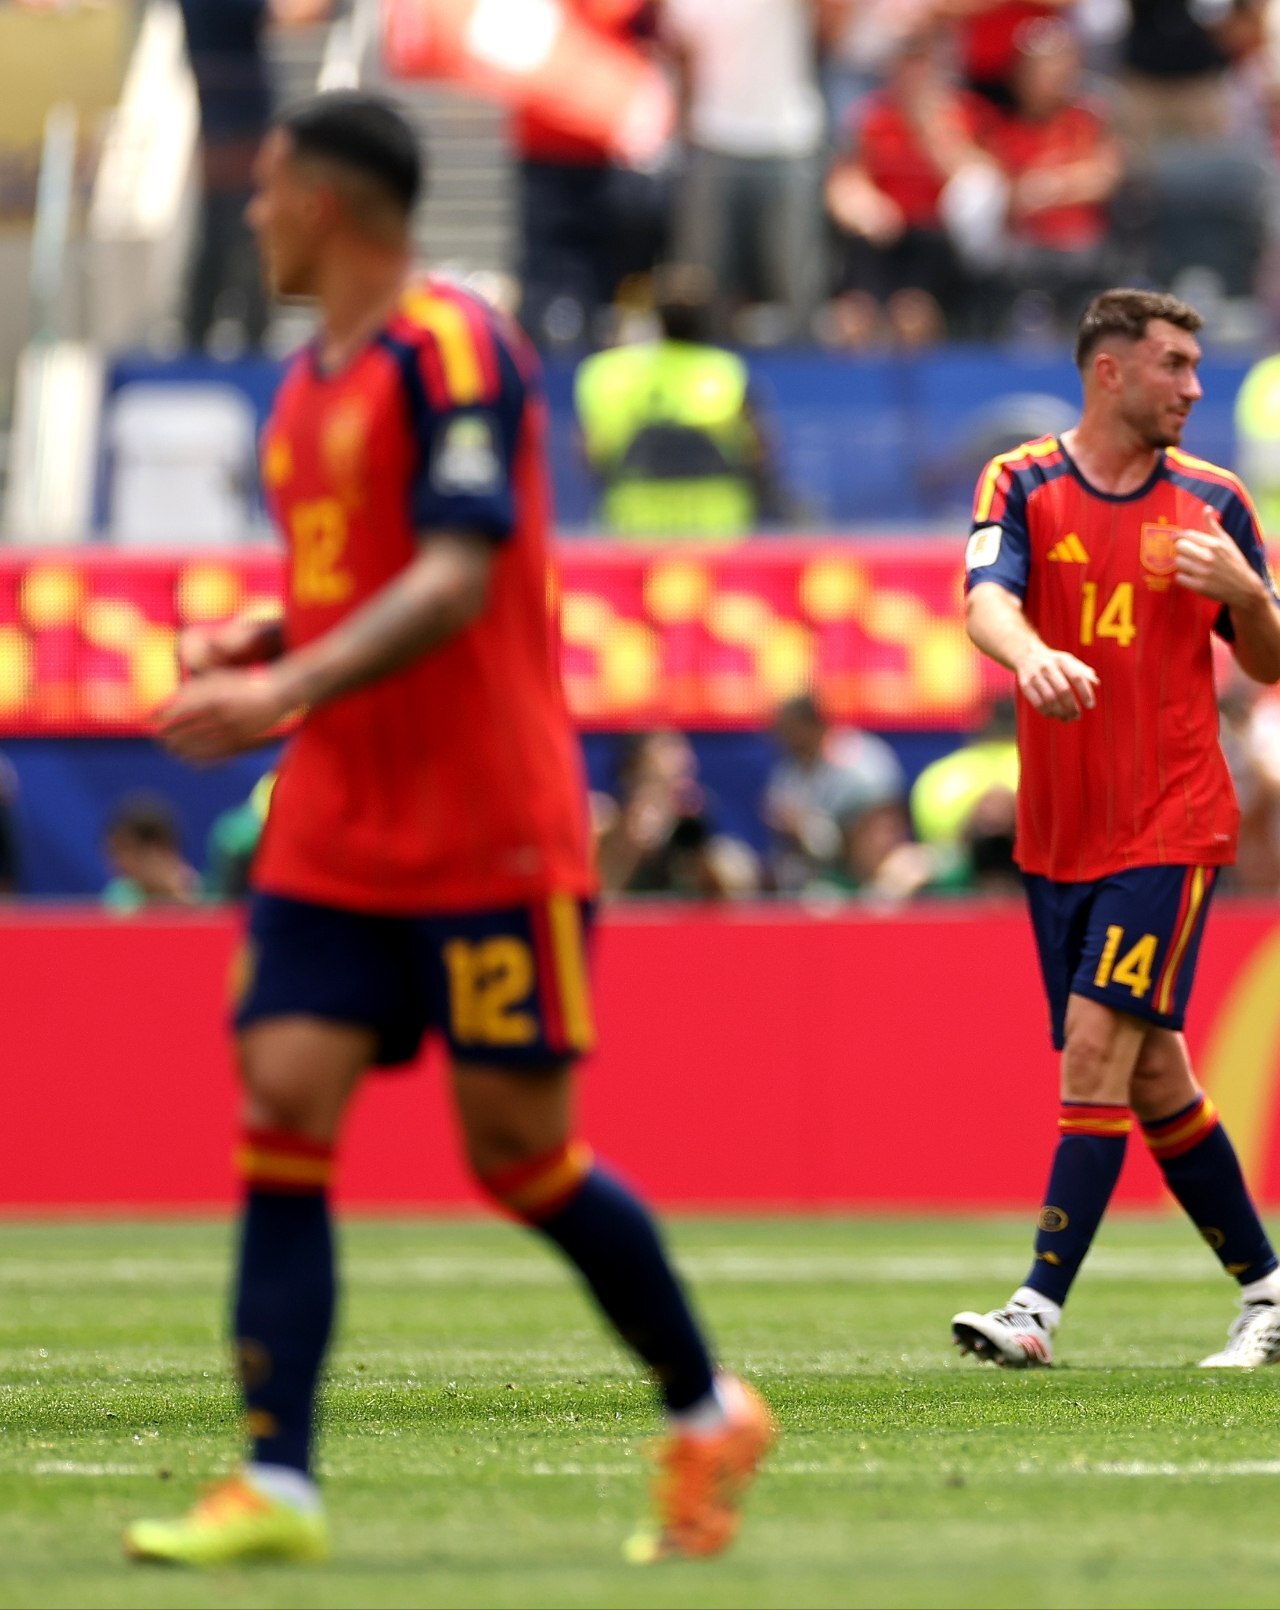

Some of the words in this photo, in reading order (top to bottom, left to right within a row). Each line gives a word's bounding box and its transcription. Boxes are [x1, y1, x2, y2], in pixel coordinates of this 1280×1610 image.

[291, 498, 353, 604] 12
[1081, 581, 1135, 647] 14
[444, 937, 537, 1045] 12
[1093, 924, 1158, 998] 14
